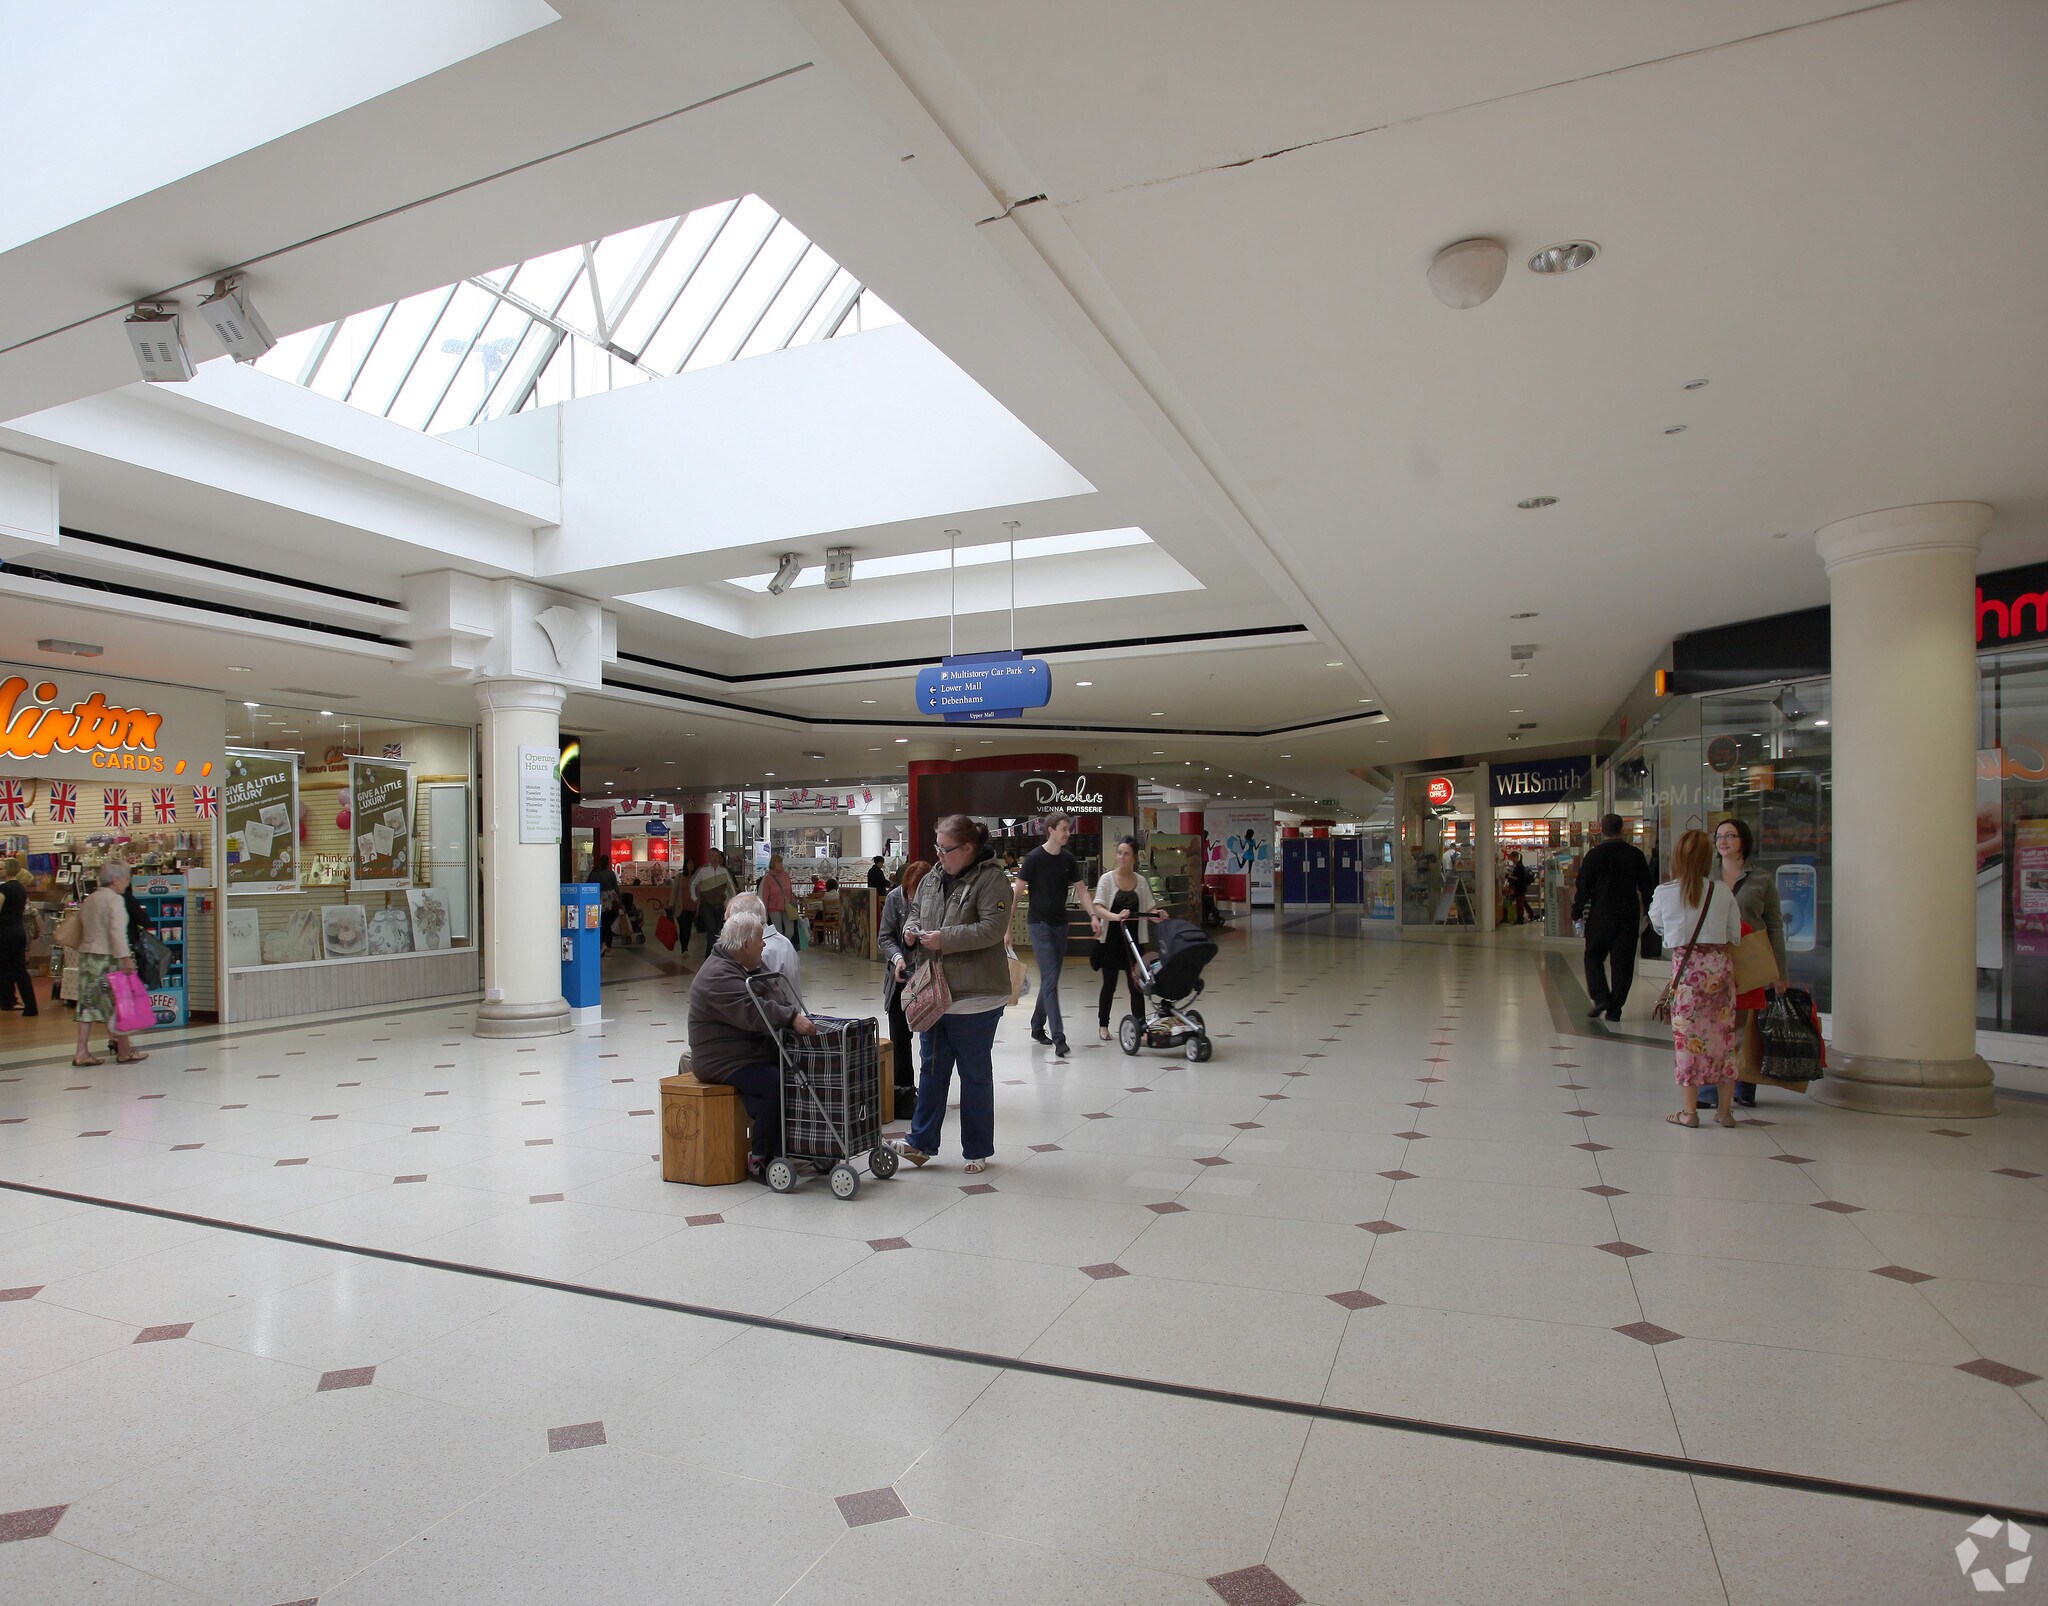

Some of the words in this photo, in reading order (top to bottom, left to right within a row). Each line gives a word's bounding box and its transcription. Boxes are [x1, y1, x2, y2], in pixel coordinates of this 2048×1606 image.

[950, 669, 989, 680] Multistorey
[991, 667, 1004, 676] Car
[1006, 666, 1023, 675] Park
[941, 684, 962, 693] Lower
[965, 682, 982, 691] Mall
[941, 696, 983, 705] Debenhams
[0, 675, 163, 760] linton
[91, 752, 165, 772] CARDS
[525, 753, 555, 764] Opening
[525, 762, 548, 771] Hours
[225, 783, 245, 797] GIVE
[246, 780, 254, 790] A
[254, 772, 286, 788] LITTLE
[1431, 783, 1445, 791] POST
[1496, 769, 1581, 796] WHSmith
[357, 790, 373, 801] GIVE
[374, 788, 381, 796] A
[381, 780, 402, 793] LITTLE
[1020, 775, 1103, 804] Druckers
[1429, 790, 1447, 798] OFFICE
[225, 788, 263, 805] LUXURY
[359, 793, 387, 810] LUXURY
[1066, 805, 1103, 813] PATISSERIE
[316, 853, 342, 863] Think
[150, 995, 173, 1008] OFFEE
